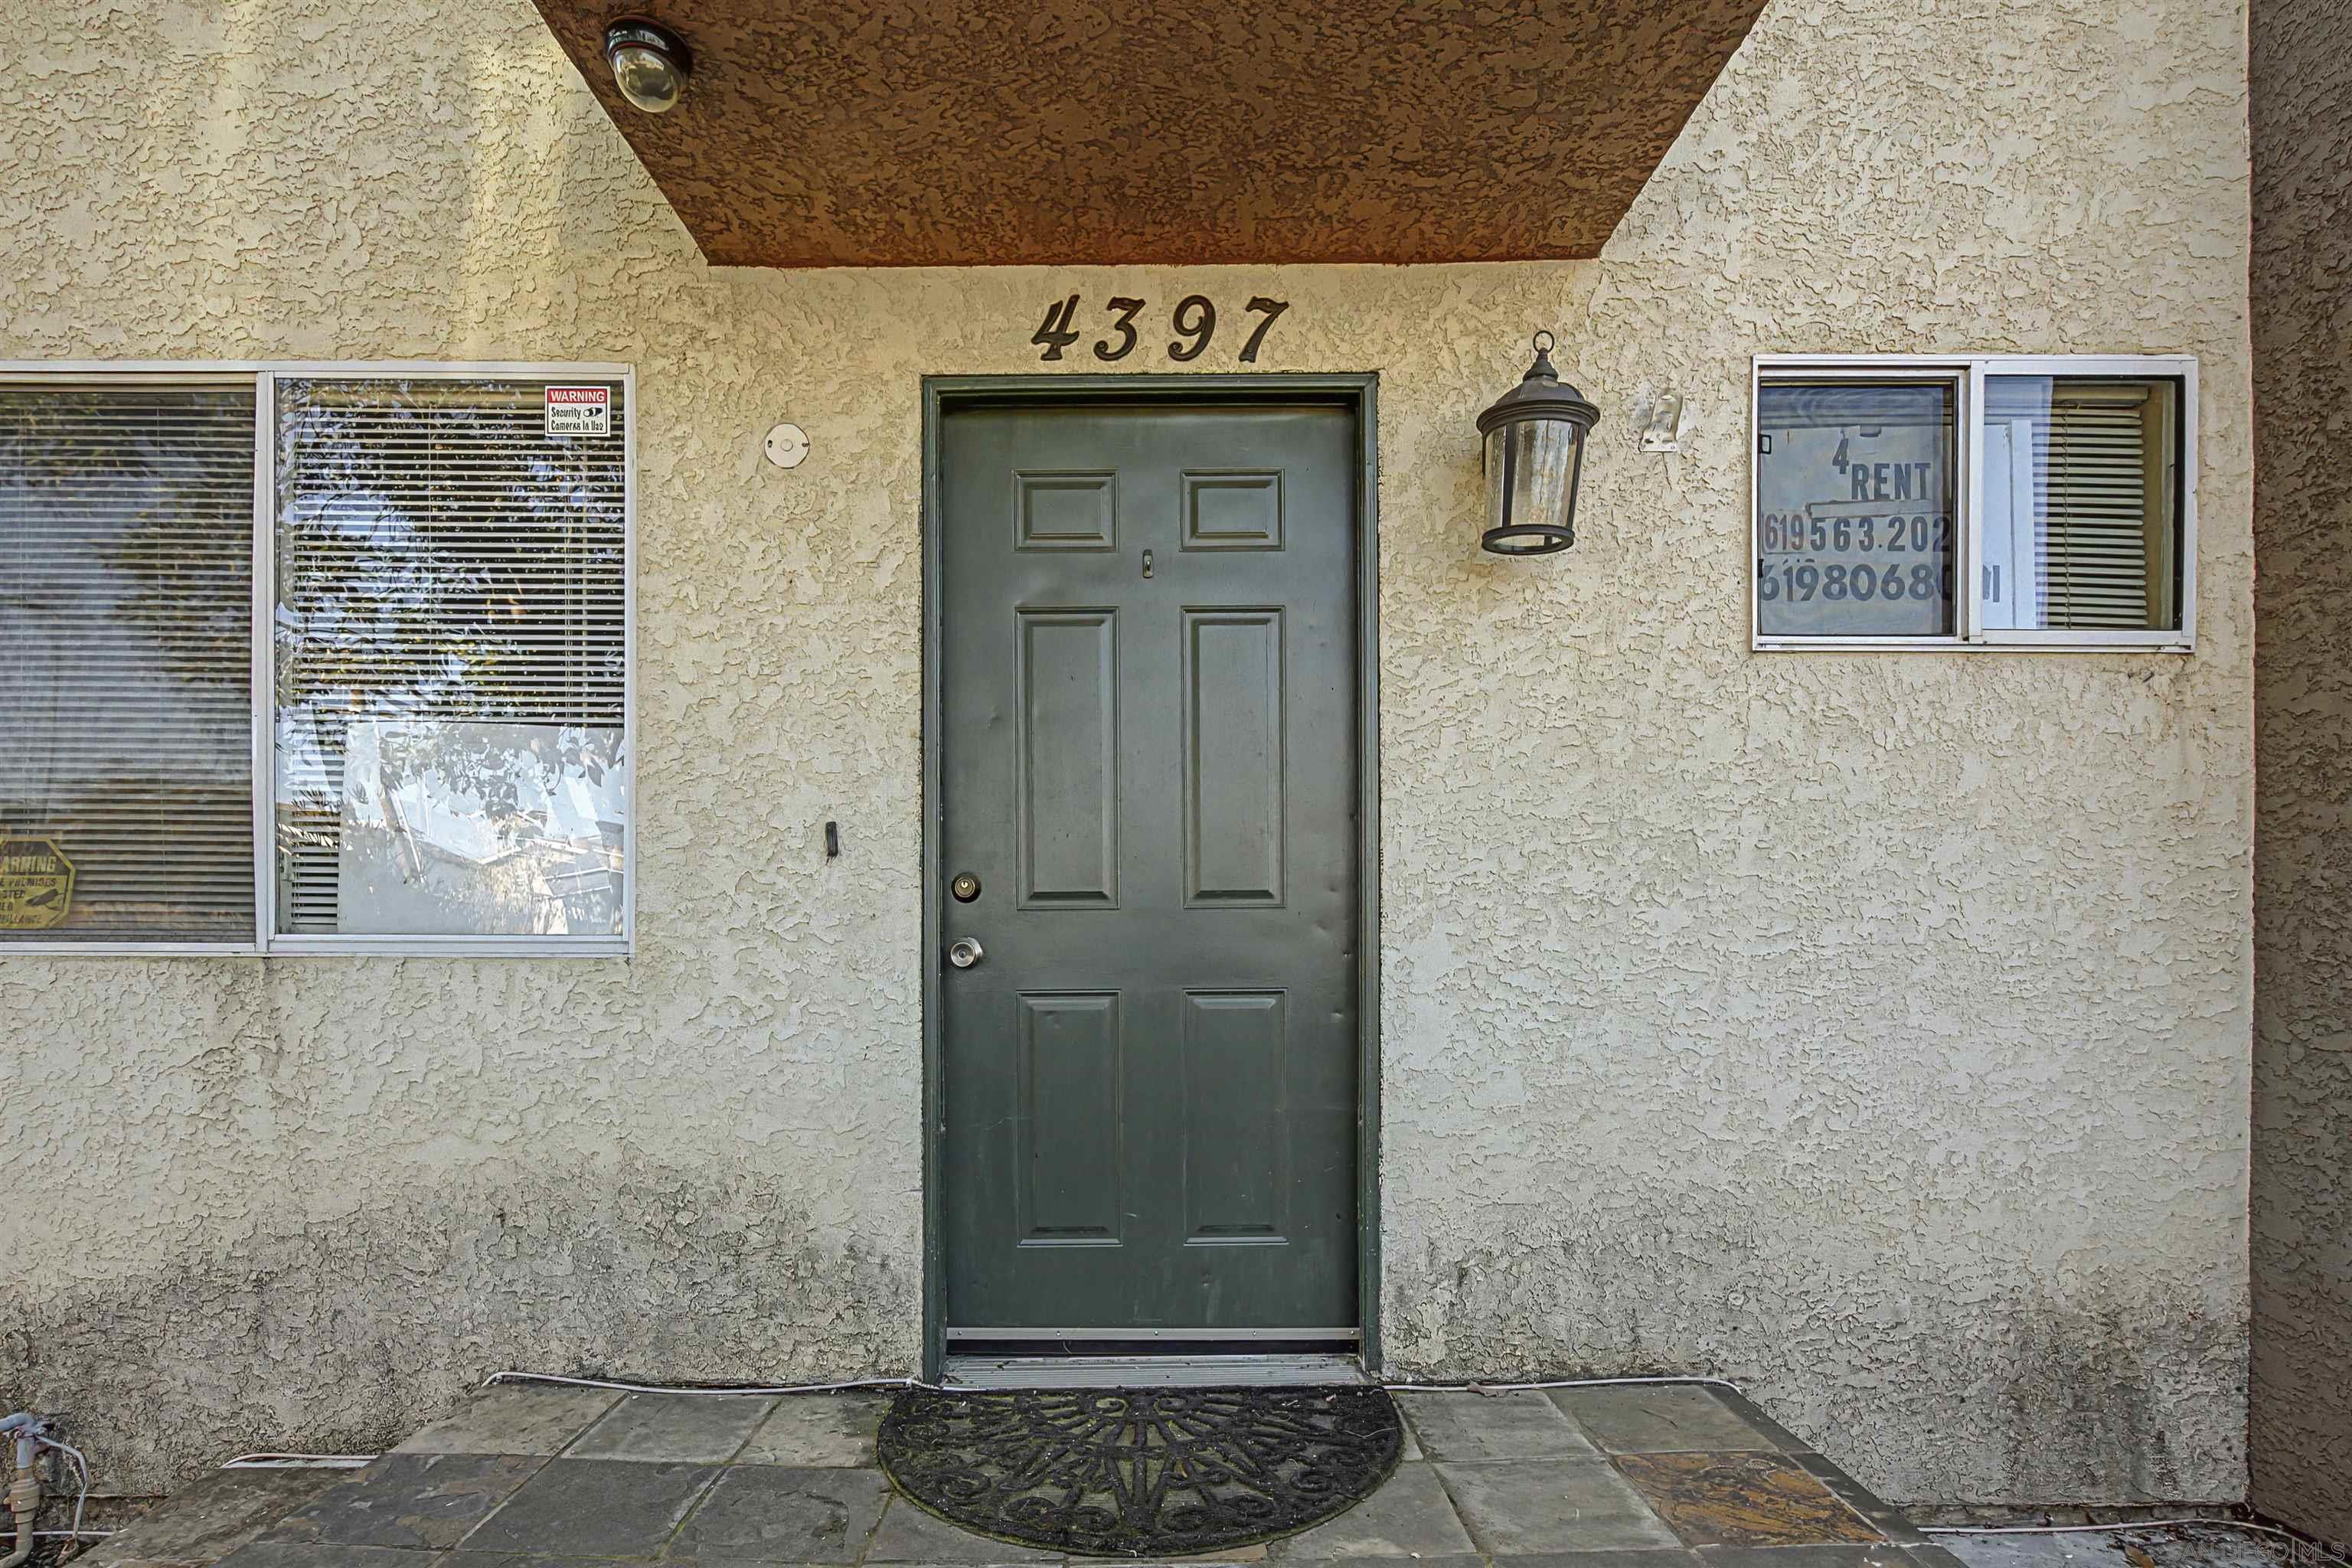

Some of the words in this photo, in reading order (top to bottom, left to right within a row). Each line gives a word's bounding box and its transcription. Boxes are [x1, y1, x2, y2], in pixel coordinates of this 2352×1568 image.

[1031, 294, 1289, 363] 4397
[550, 390, 605, 402] WARNING
[551, 407, 581, 420] Security
[551, 420, 581, 430] Cameras
[591, 420, 603, 430] Use
[1832, 438, 1849, 475] 4
[1851, 462, 1931, 501] RENT
[0, 857, 57, 872] ARNING
